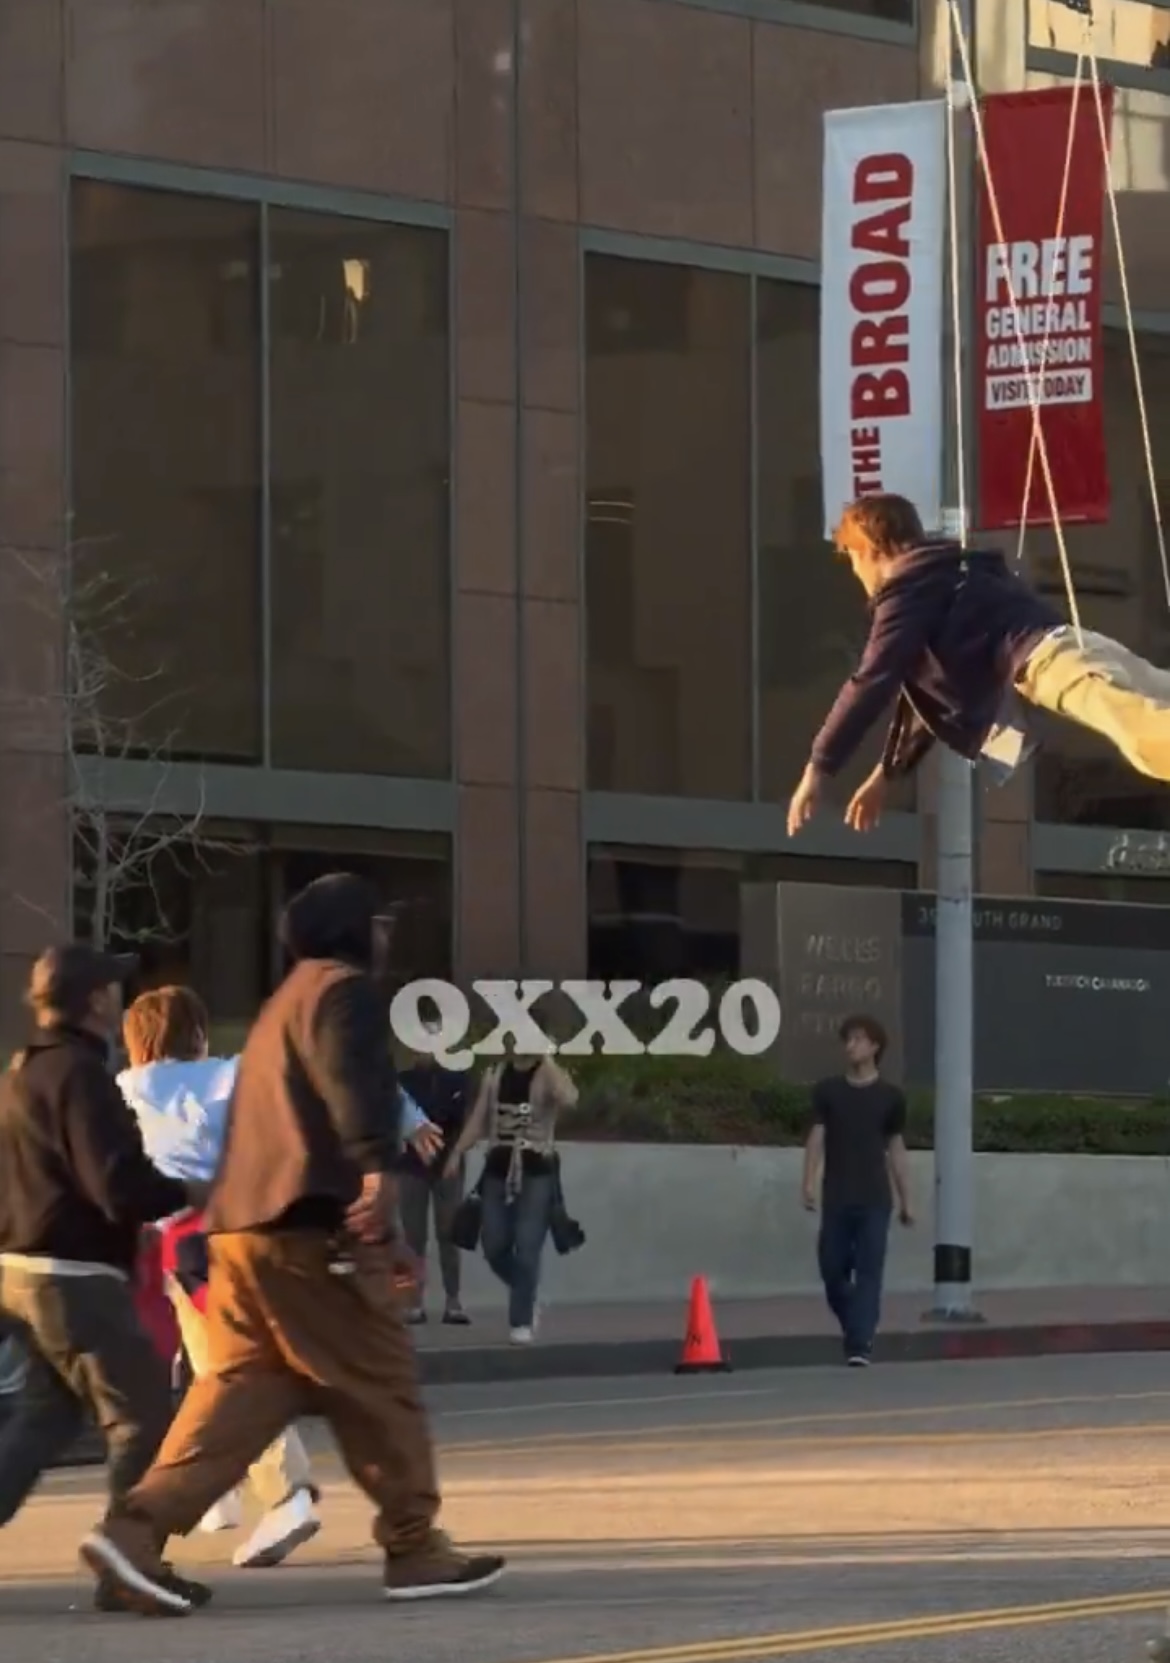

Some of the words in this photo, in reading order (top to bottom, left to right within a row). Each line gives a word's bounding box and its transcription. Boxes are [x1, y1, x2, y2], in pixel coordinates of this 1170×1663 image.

[849, 152, 914, 420] BROAD
[986, 235, 1094, 302] FREE
[986, 301, 1091, 339] GENERAL
[987, 337, 1091, 369] ADMISSION
[991, 379, 1029, 403] VISIT
[851, 426, 882, 498] THE
[1006, 911, 1062, 930] GRAND
